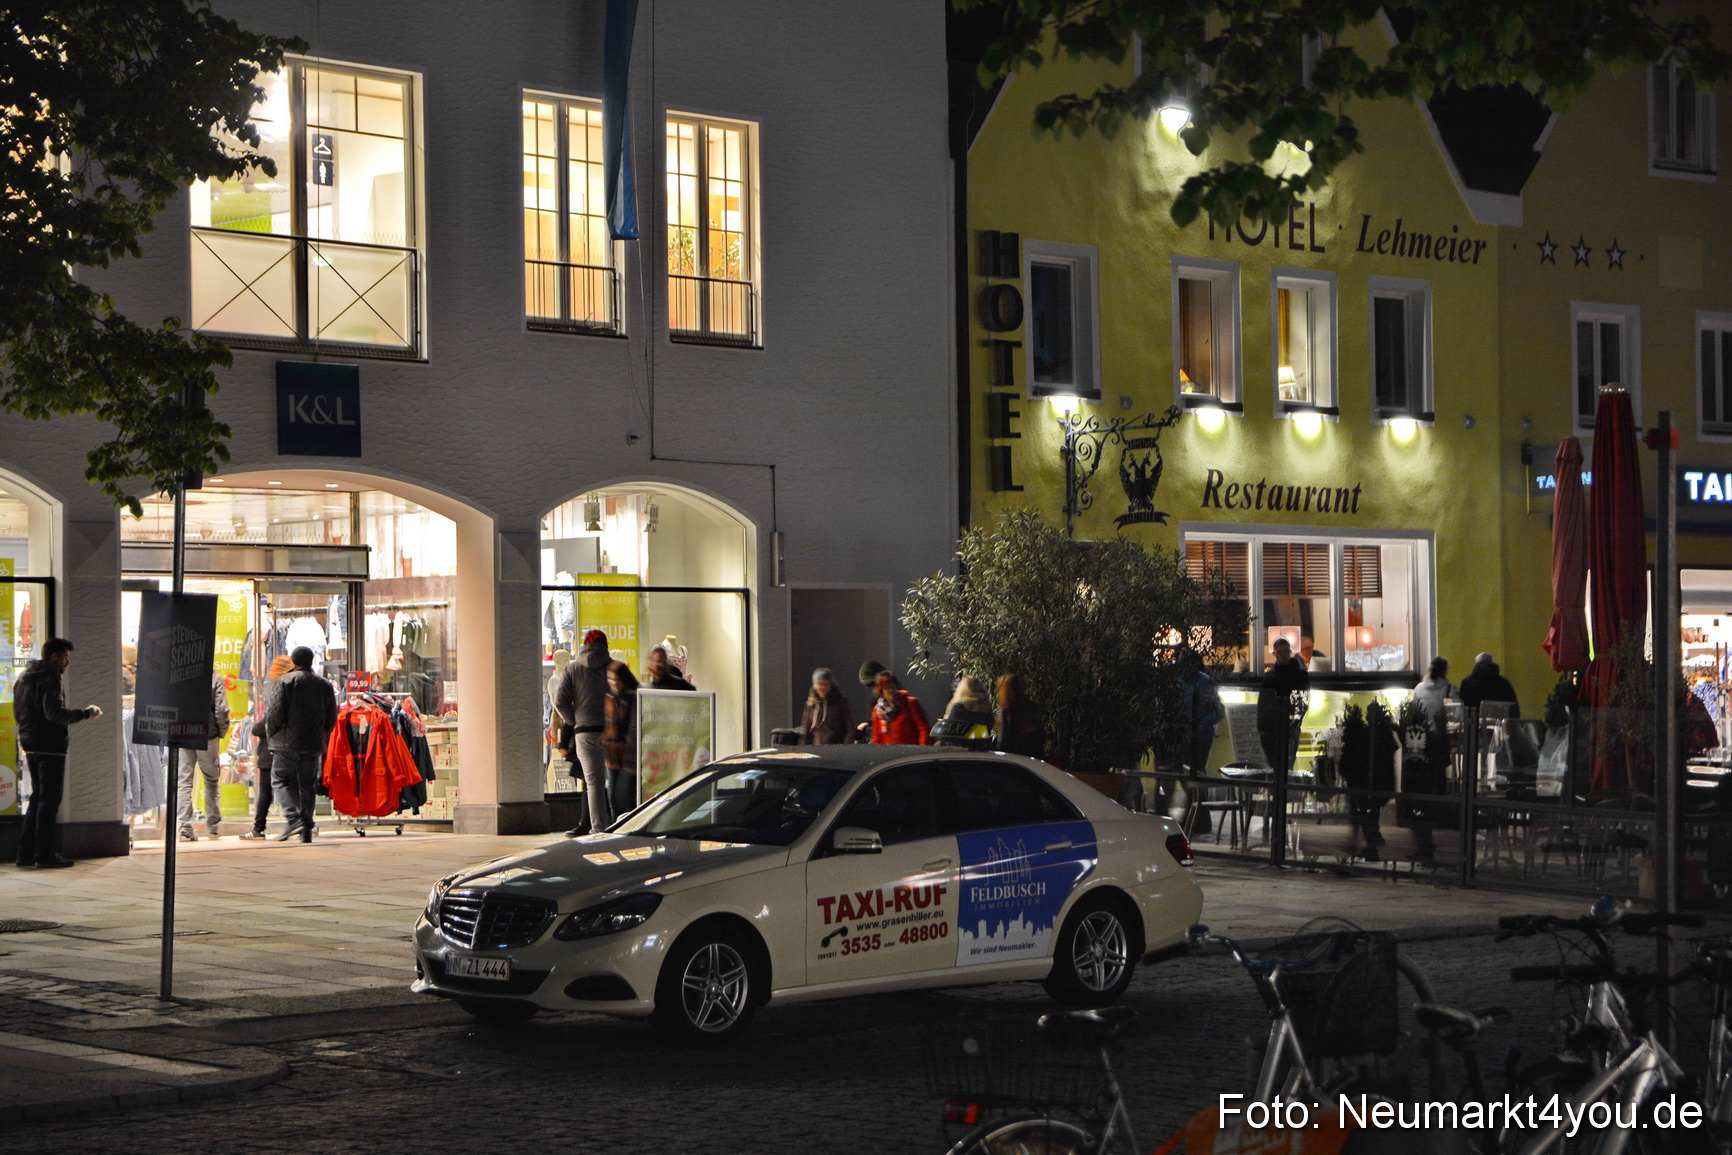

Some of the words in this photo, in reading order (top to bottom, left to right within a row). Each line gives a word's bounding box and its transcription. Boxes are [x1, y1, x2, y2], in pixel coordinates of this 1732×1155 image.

[1357, 214, 1487, 265] Lehmeier
[981, 229, 1024, 493] HOTEL
[288, 393, 356, 425] K&L
[1200, 468, 1362, 514] Restaurant
[170, 640, 207, 669] SCHON
[139, 720, 150, 729] zur
[147, 707, 177, 720] Konzerne
[817, 882, 947, 925] TAXI-RUF
[970, 882, 1046, 902] FELDBUSCH
[856, 910, 944, 931] www.grasenhiller.eu
[841, 933, 881, 956] 3535
[899, 921, 948, 945] 48800
[970, 946, 981, 955] Wir
[983, 945, 998, 954] sind
[483, 960, 506, 978] 444
